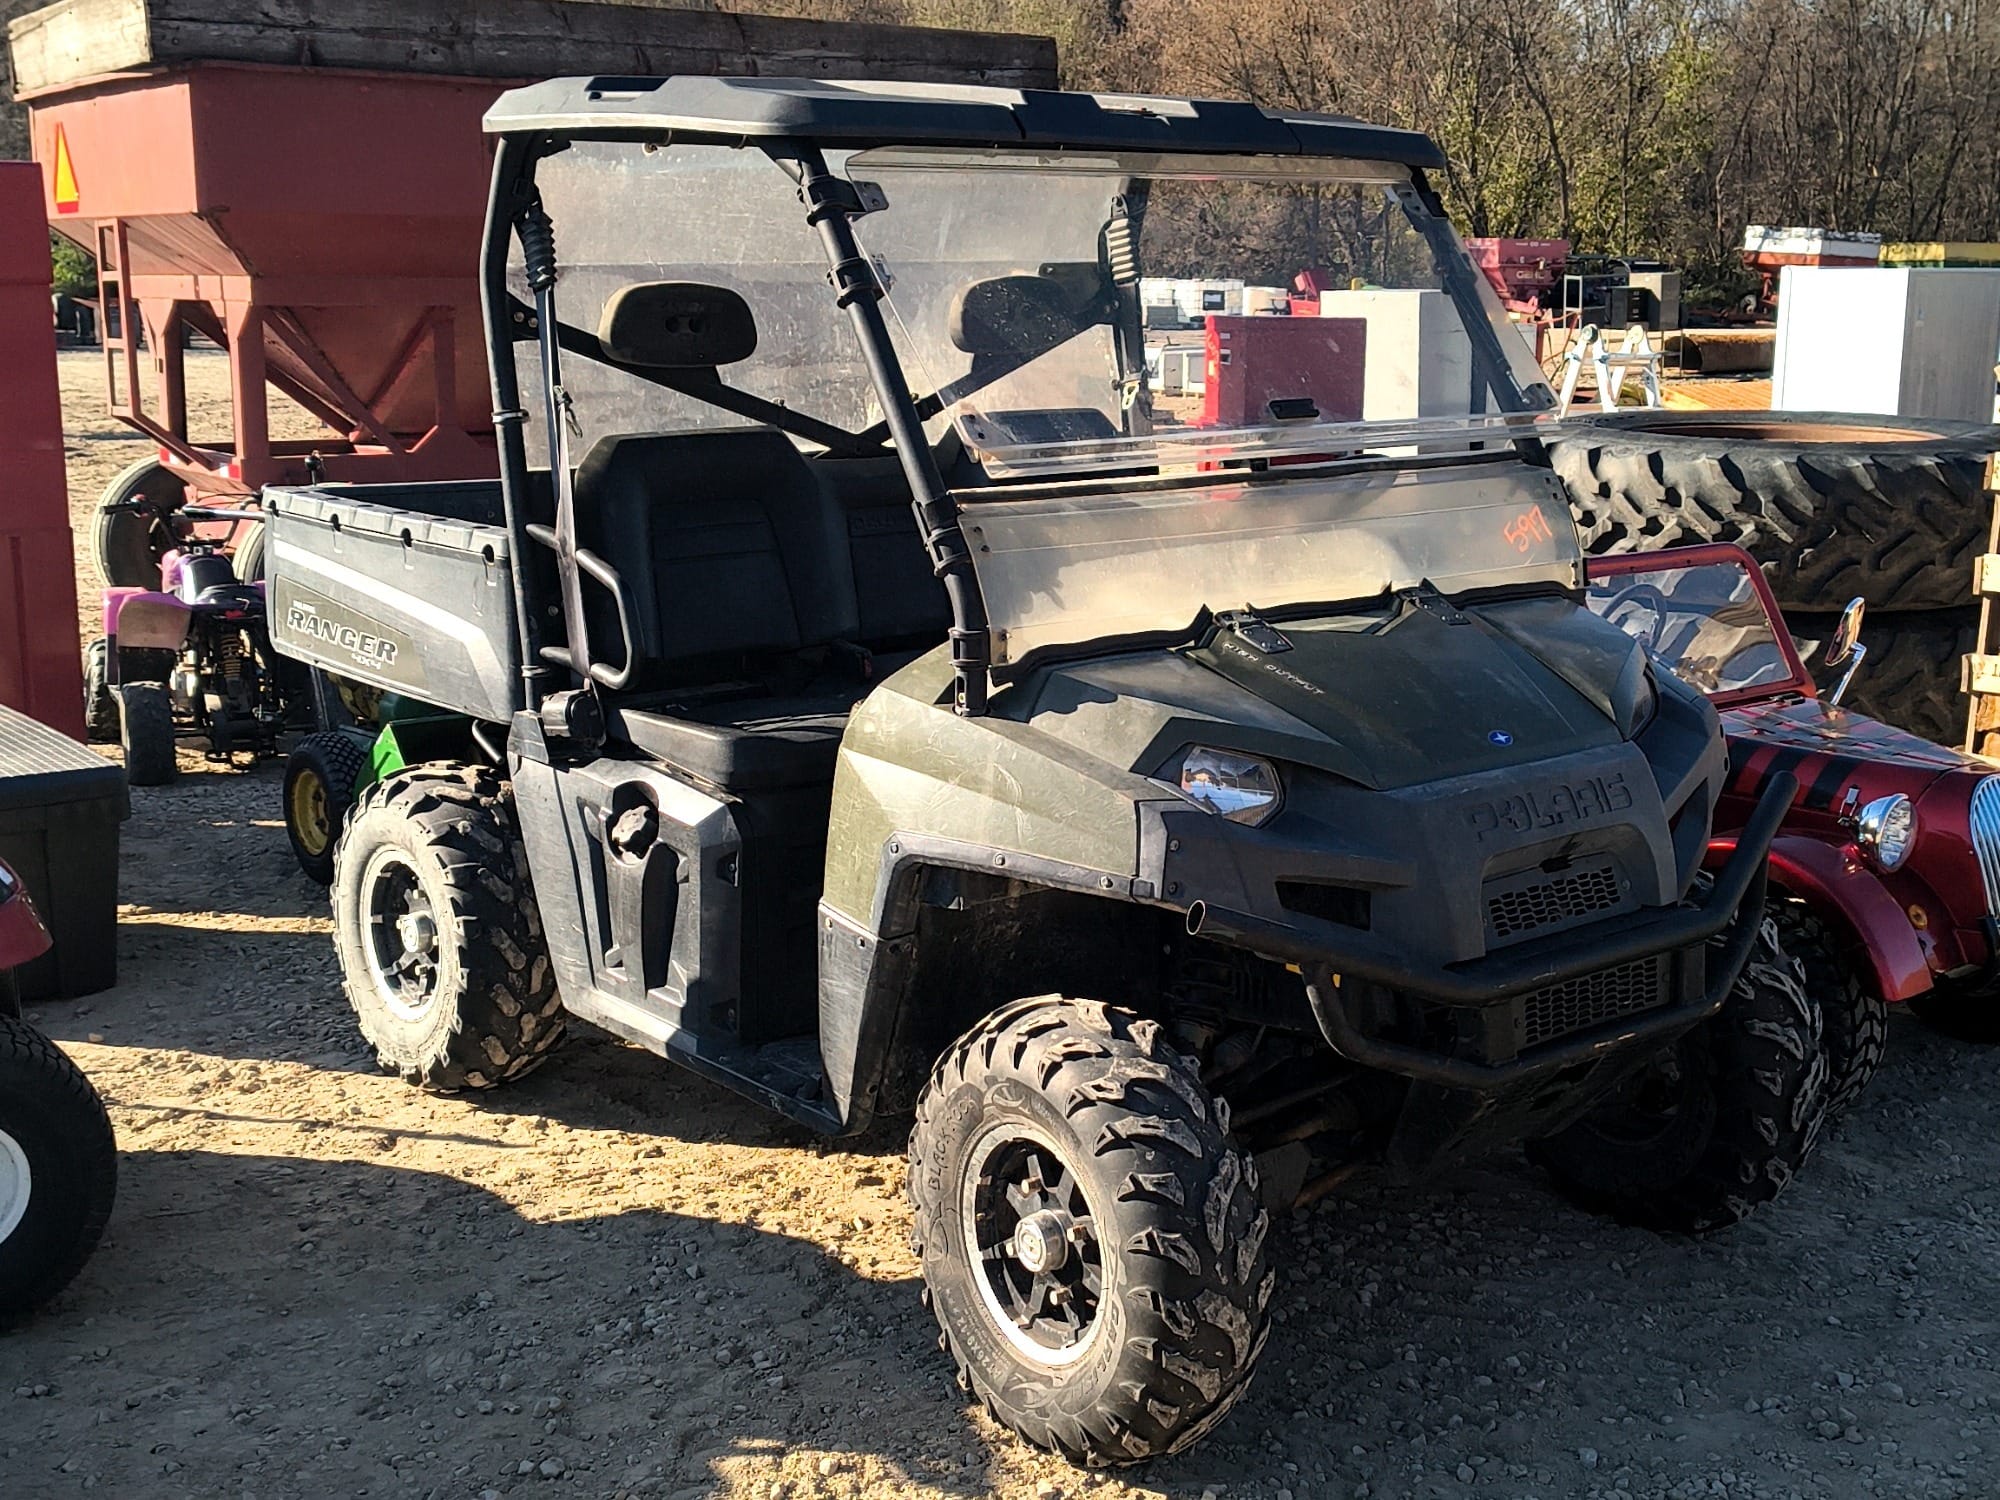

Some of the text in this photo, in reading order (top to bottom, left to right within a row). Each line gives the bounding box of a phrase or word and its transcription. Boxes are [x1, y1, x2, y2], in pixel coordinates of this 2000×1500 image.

[1503, 503, 1553, 553] 597
[286, 607, 399, 666] RANGER
[1469, 772, 1633, 842] POLARIS
